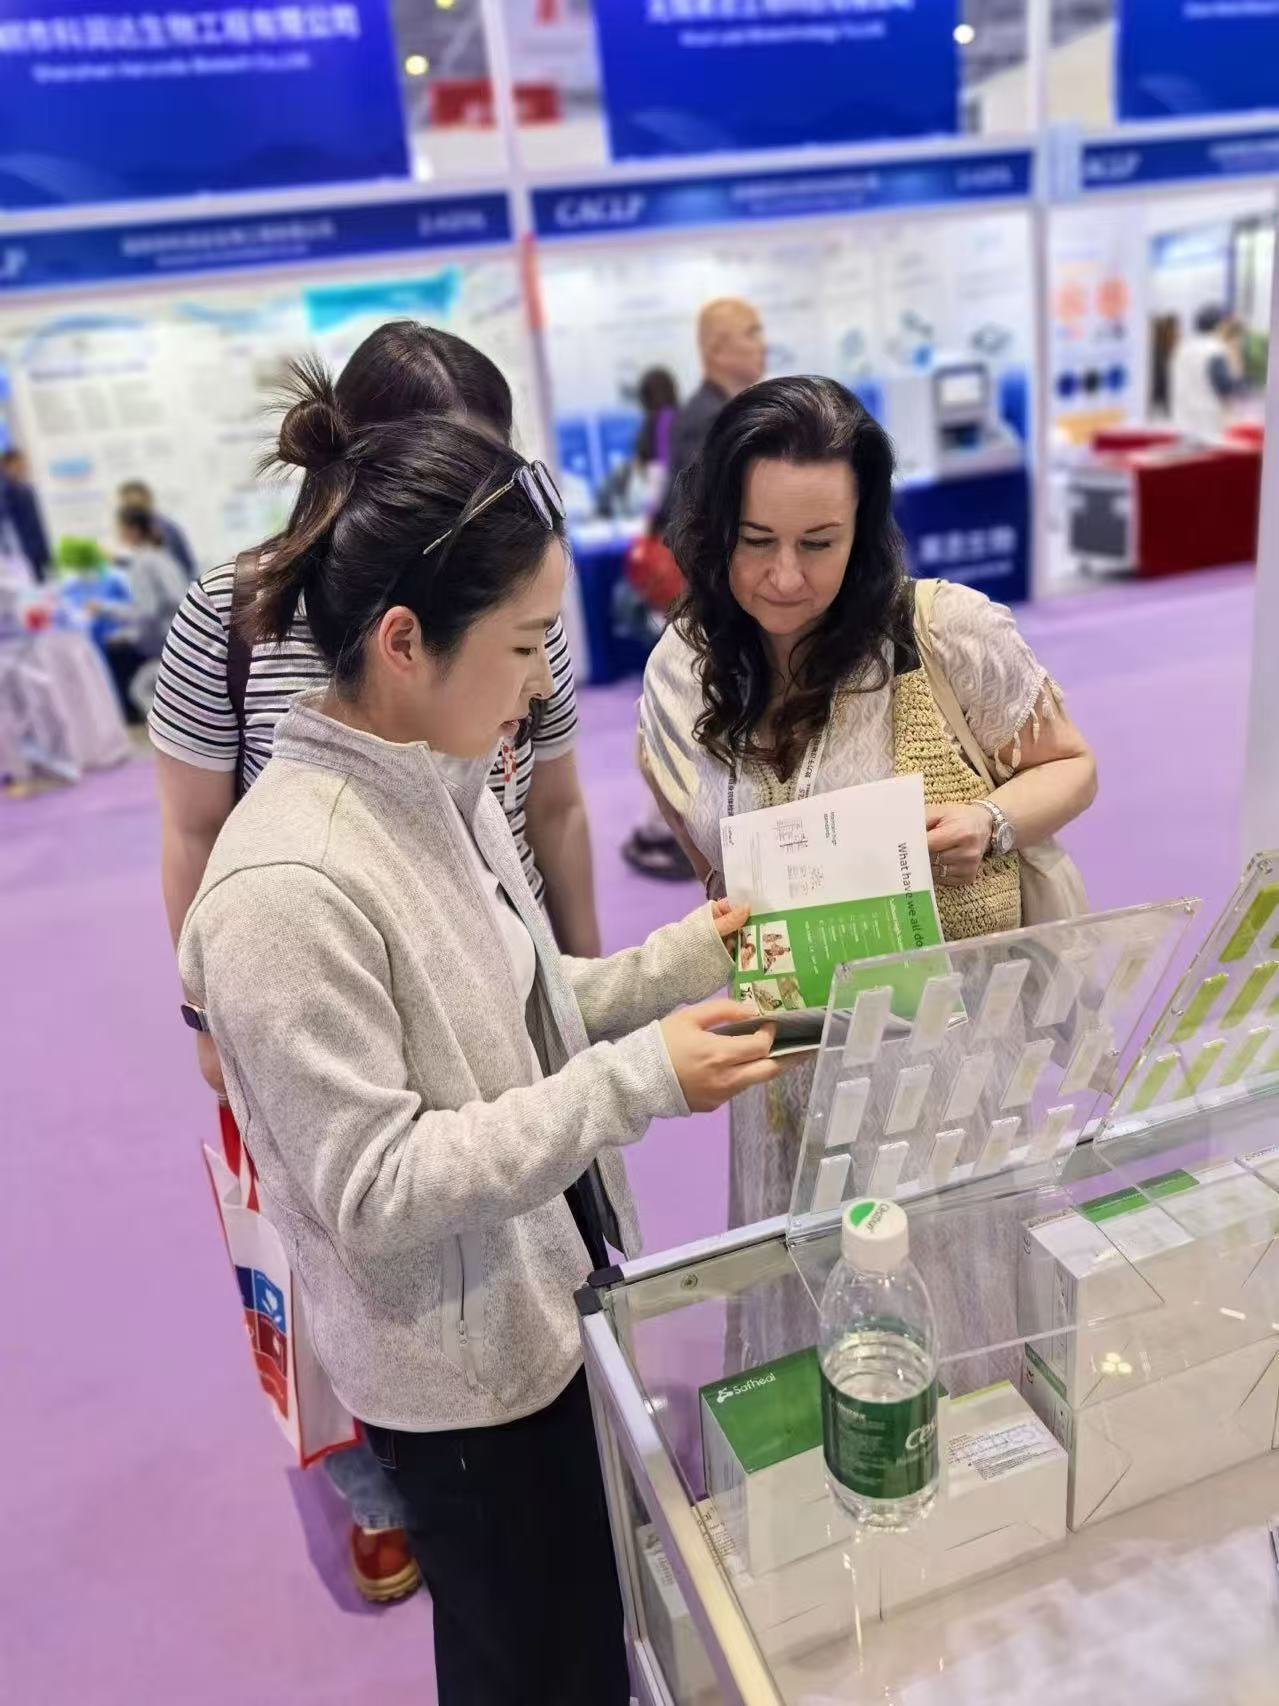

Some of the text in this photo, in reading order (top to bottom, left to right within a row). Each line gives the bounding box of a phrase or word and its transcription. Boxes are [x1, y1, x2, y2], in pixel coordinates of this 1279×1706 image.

[898, 842, 909, 871] What
[902, 872, 913, 900] have
[907, 901, 917, 917] we
[911, 918, 921, 932] all
[732, 1372, 776, 1395] Safheal
